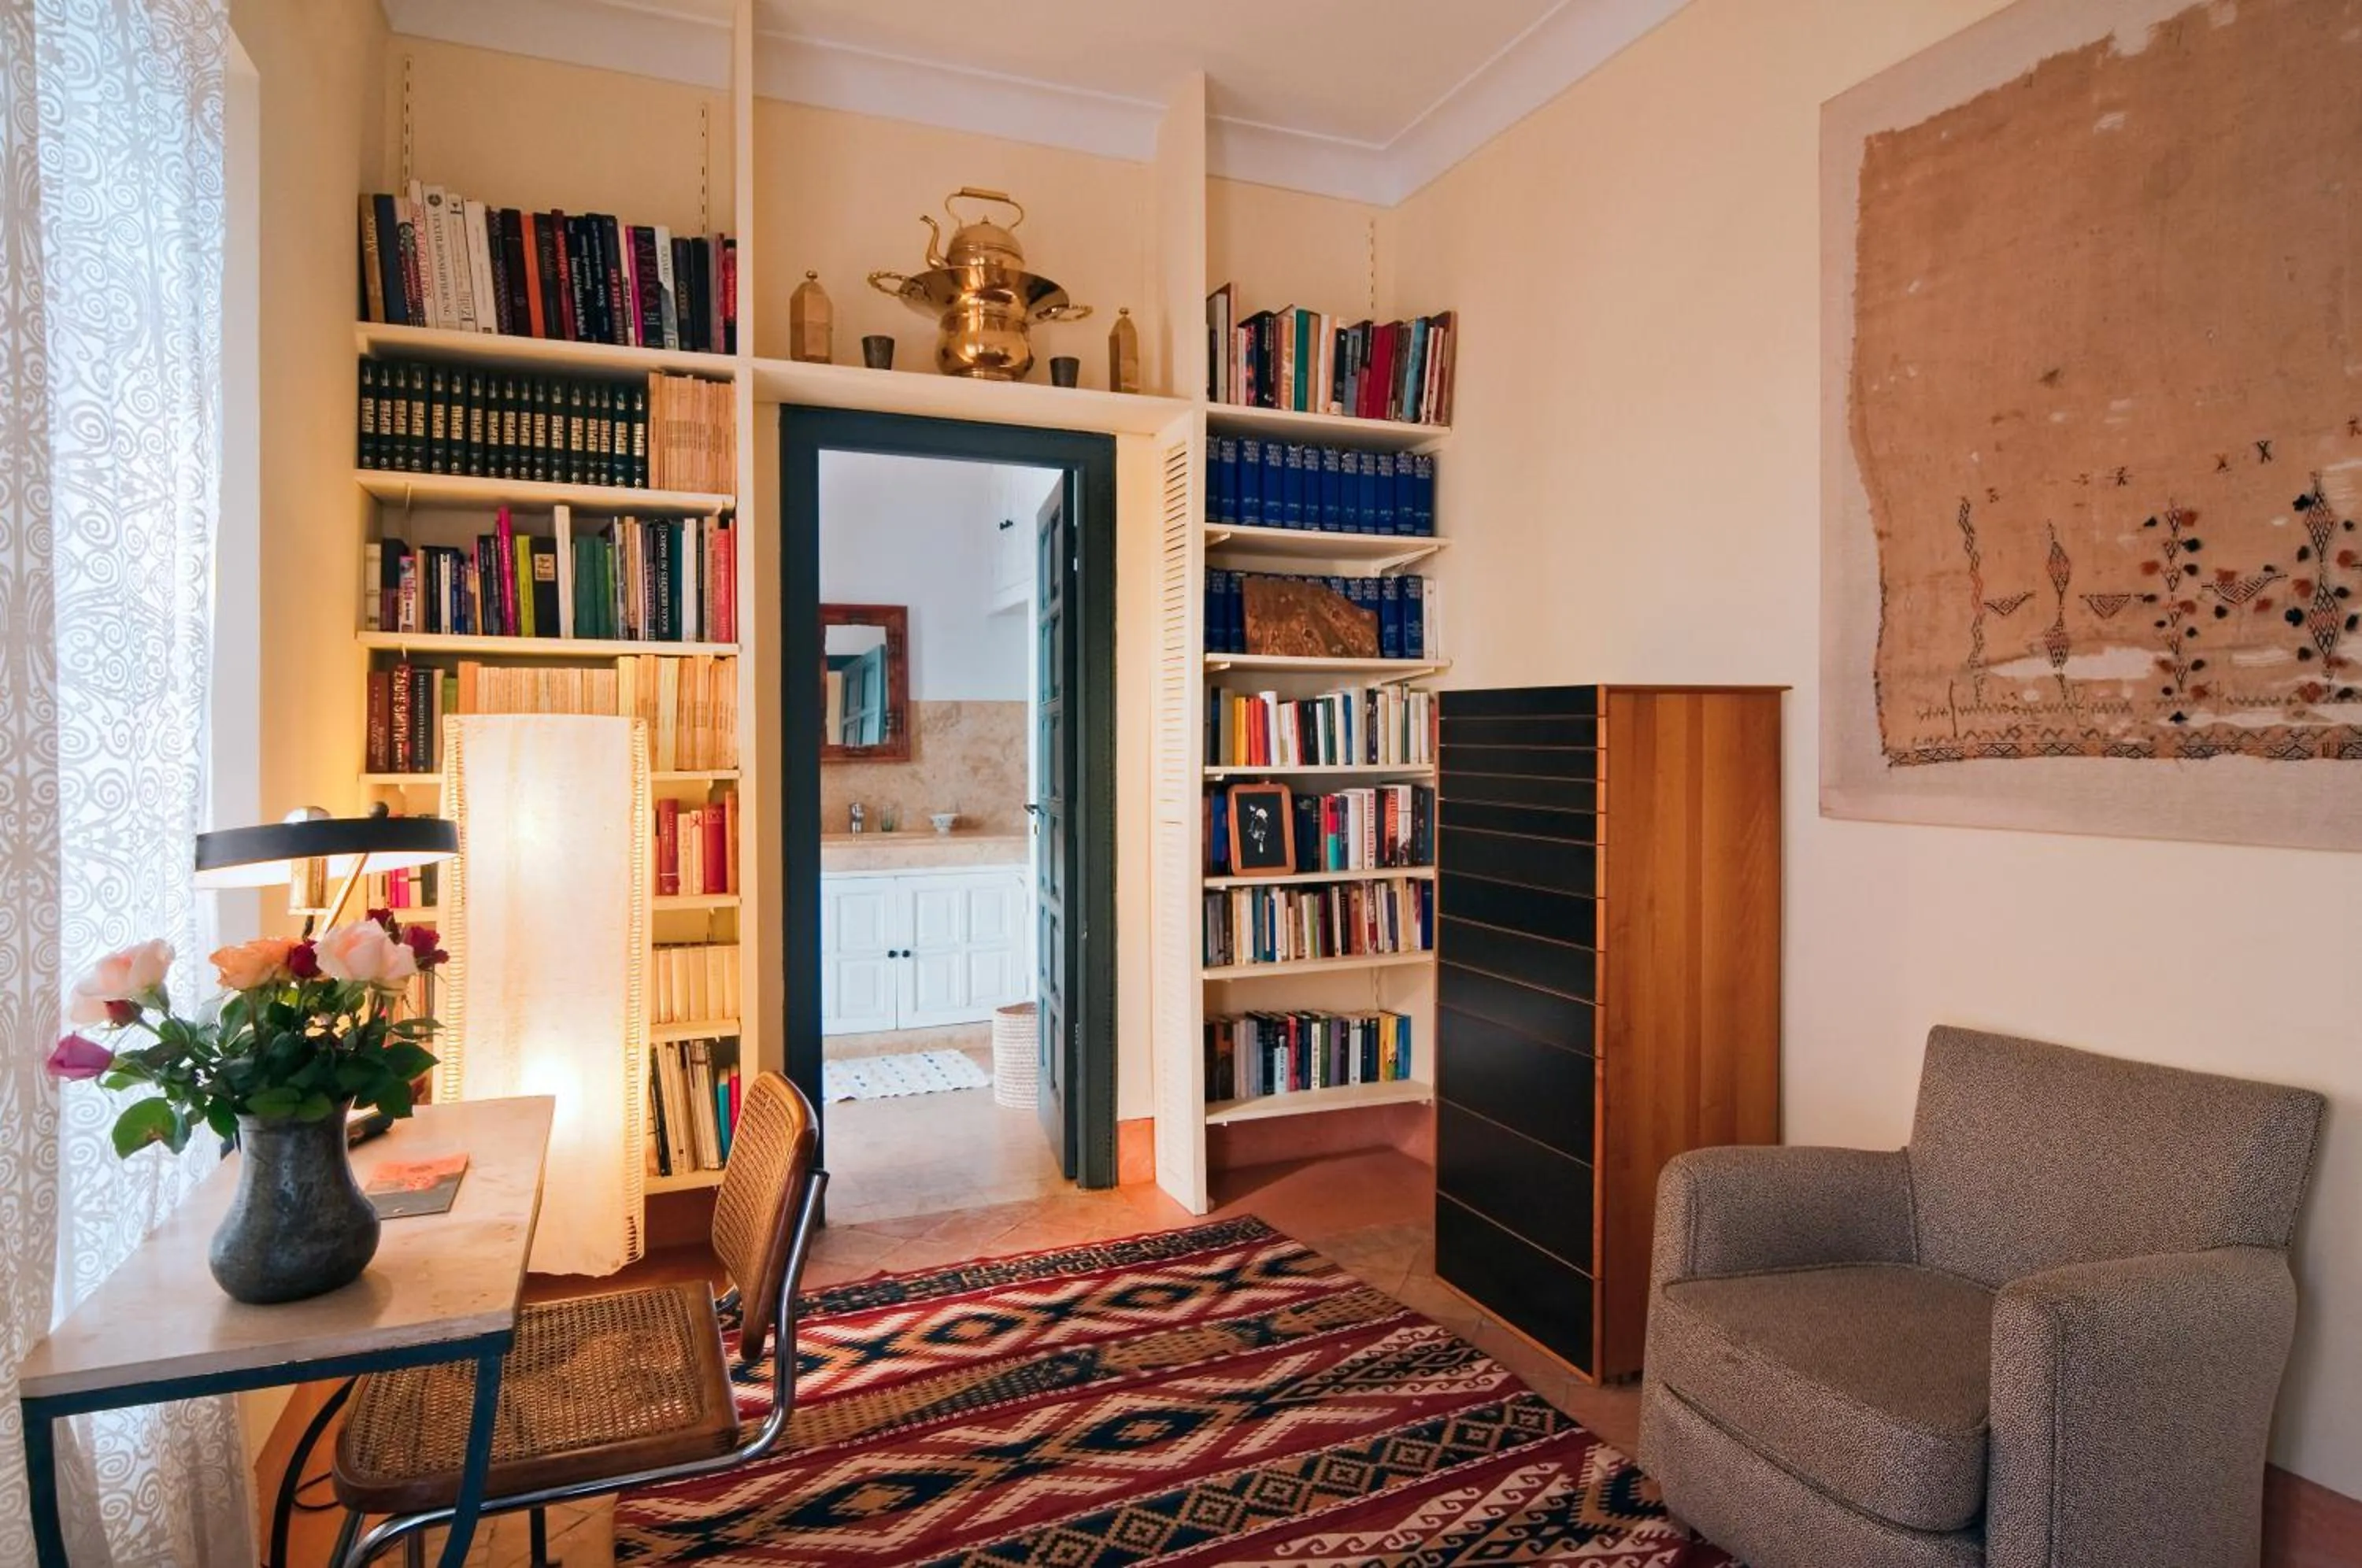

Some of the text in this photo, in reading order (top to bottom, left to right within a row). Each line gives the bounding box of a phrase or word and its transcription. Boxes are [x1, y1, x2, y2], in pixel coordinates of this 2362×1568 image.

[365, 213, 377, 253] Maroc
[638, 239, 659, 309] AFRIKA
[659, 531, 668, 557] MAROC
[393, 670, 409, 741] ZADIE SMITH
